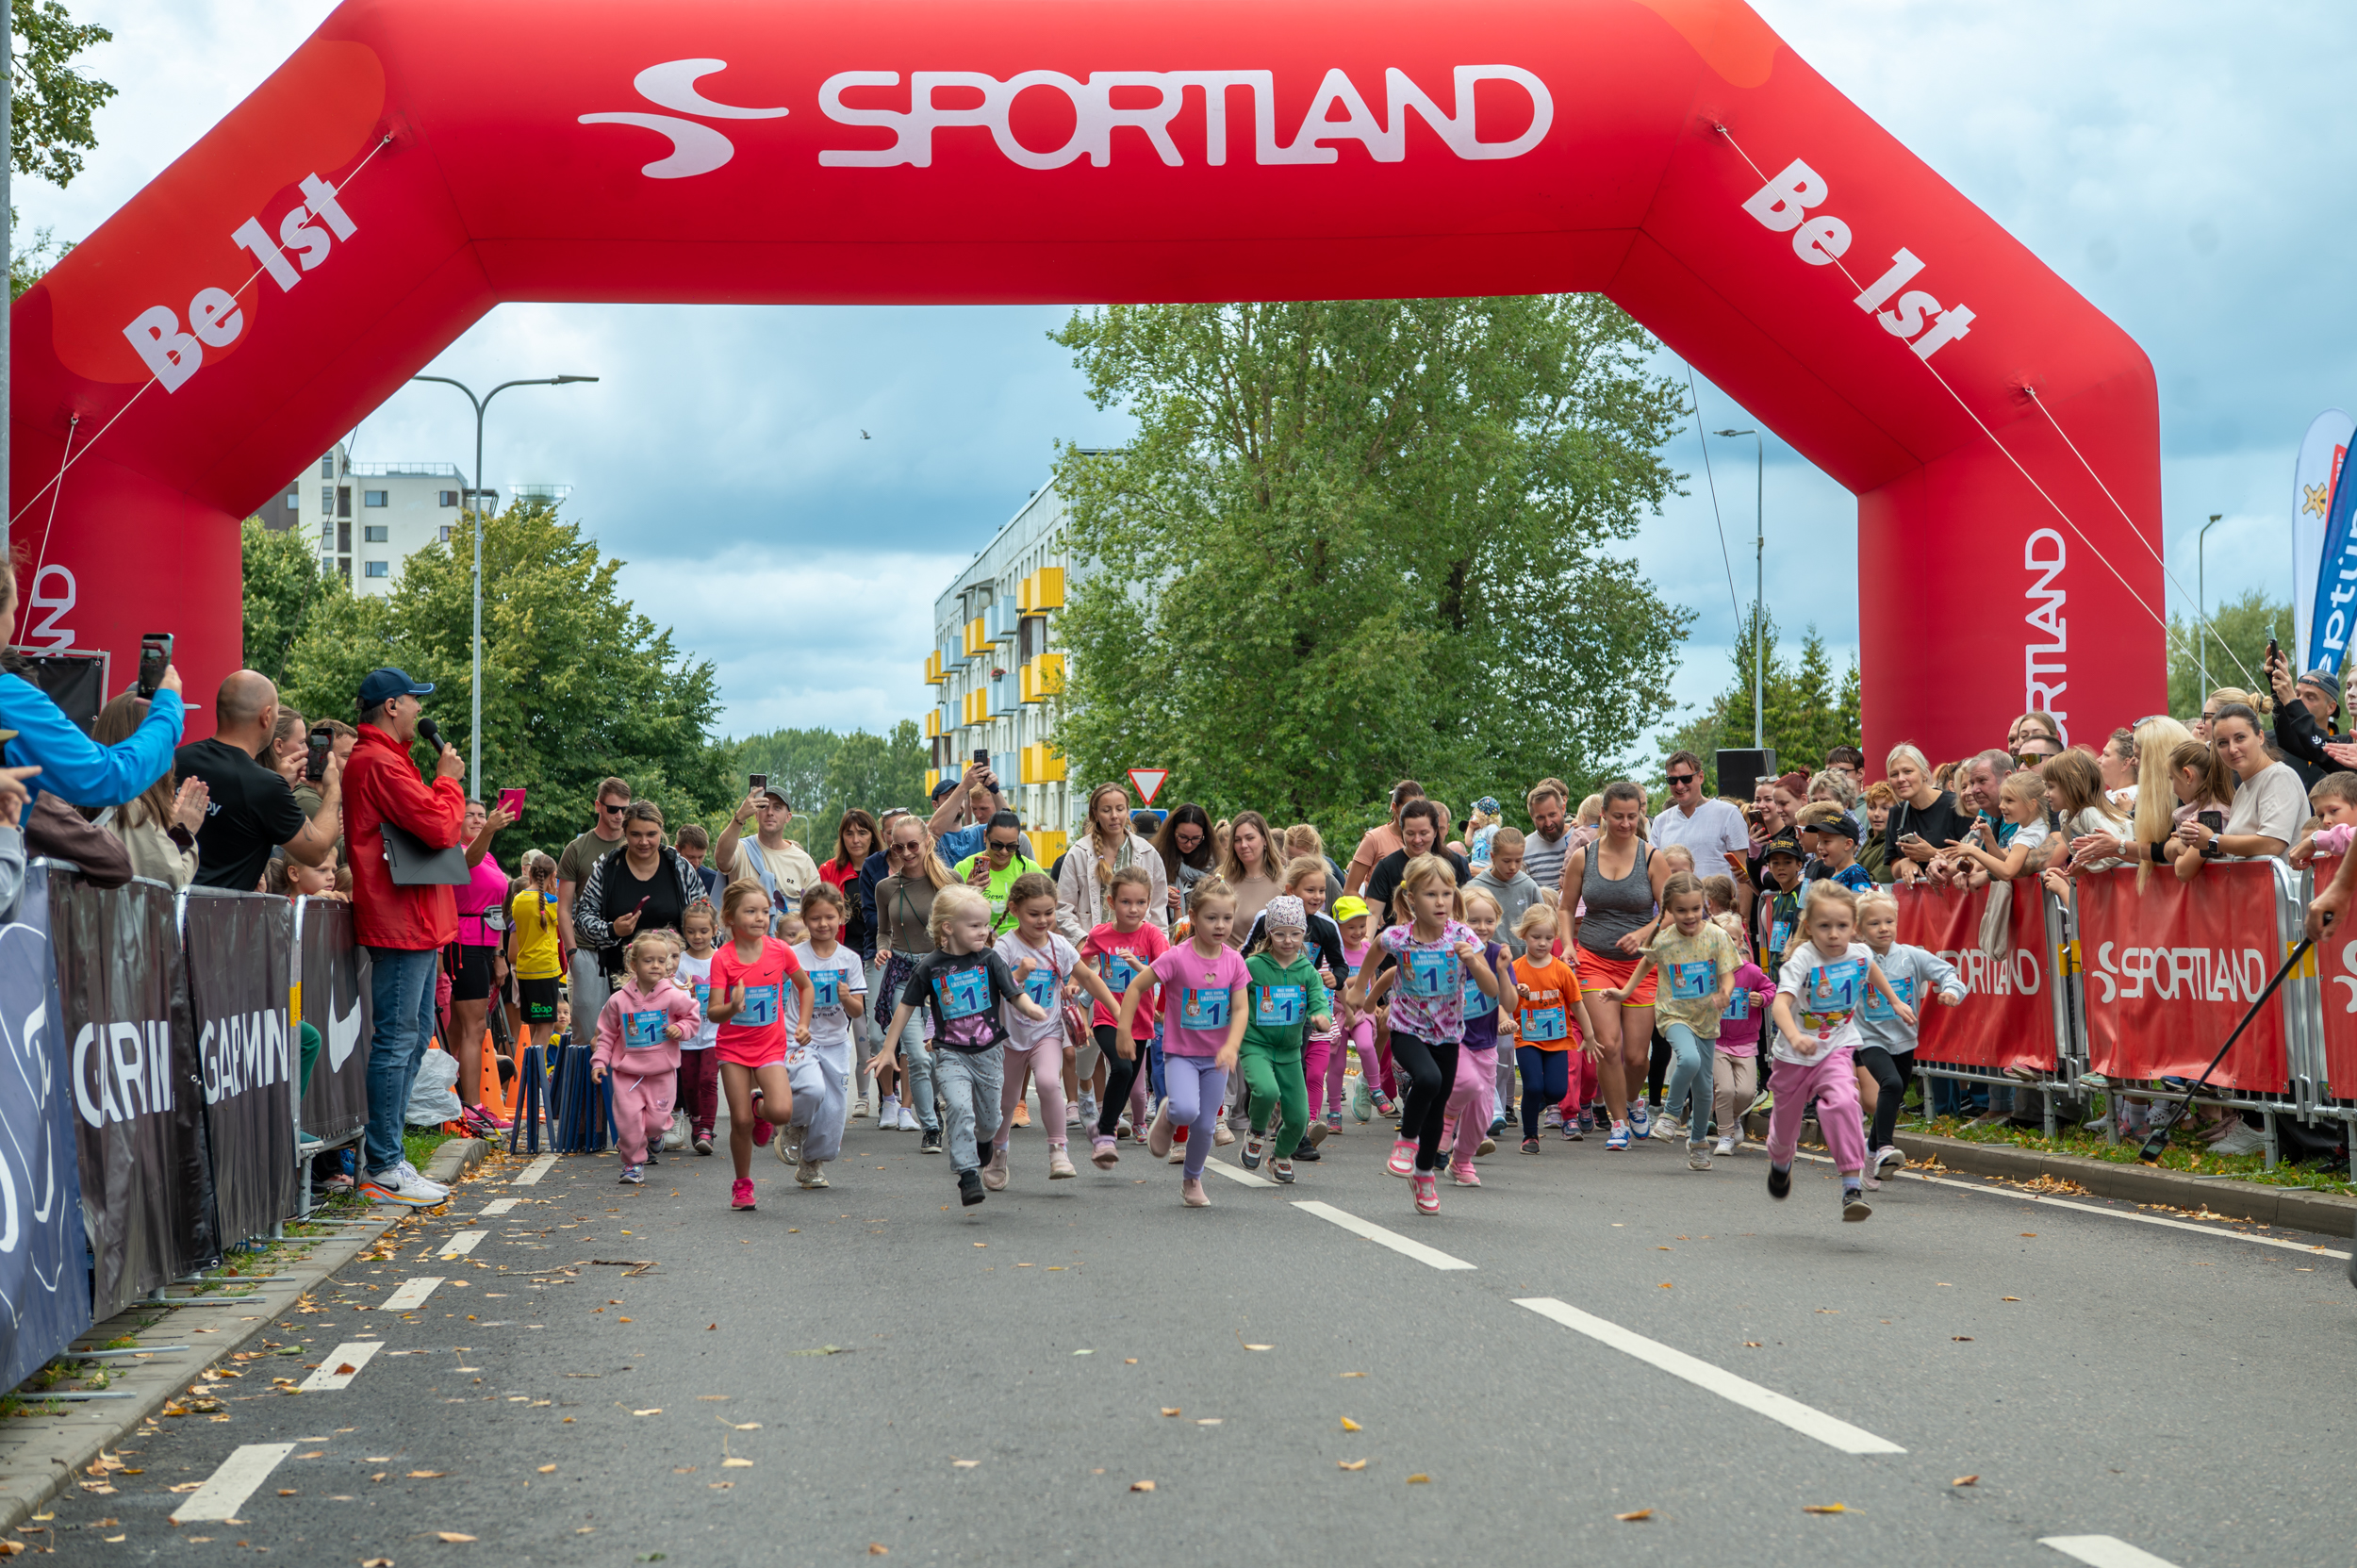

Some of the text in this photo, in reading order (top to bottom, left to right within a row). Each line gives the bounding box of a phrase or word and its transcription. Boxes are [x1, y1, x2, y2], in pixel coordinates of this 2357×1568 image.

[818, 64, 1555, 170] SPORTLAND
[1741, 157, 1977, 361] Be 1st
[123, 173, 358, 394] Be 1st
[2025, 528, 2068, 747] RTLAND
[1118, 968, 1131, 990] 1
[1423, 967, 1438, 992] 1
[1691, 974, 1705, 995] 1
[2120, 947, 2266, 1002] SPORTLAND
[819, 983, 832, 1003] 1
[961, 985, 978, 1011] 1
[1030, 982, 1044, 1005] 1
[1473, 990, 1488, 1012] 1
[1838, 978, 1853, 1005] 1
[752, 999, 766, 1023] 1
[1207, 1002, 1221, 1026] 1
[1279, 999, 1293, 1022] 1
[644, 1023, 656, 1043] 1
[1541, 1019, 1553, 1038] 1
